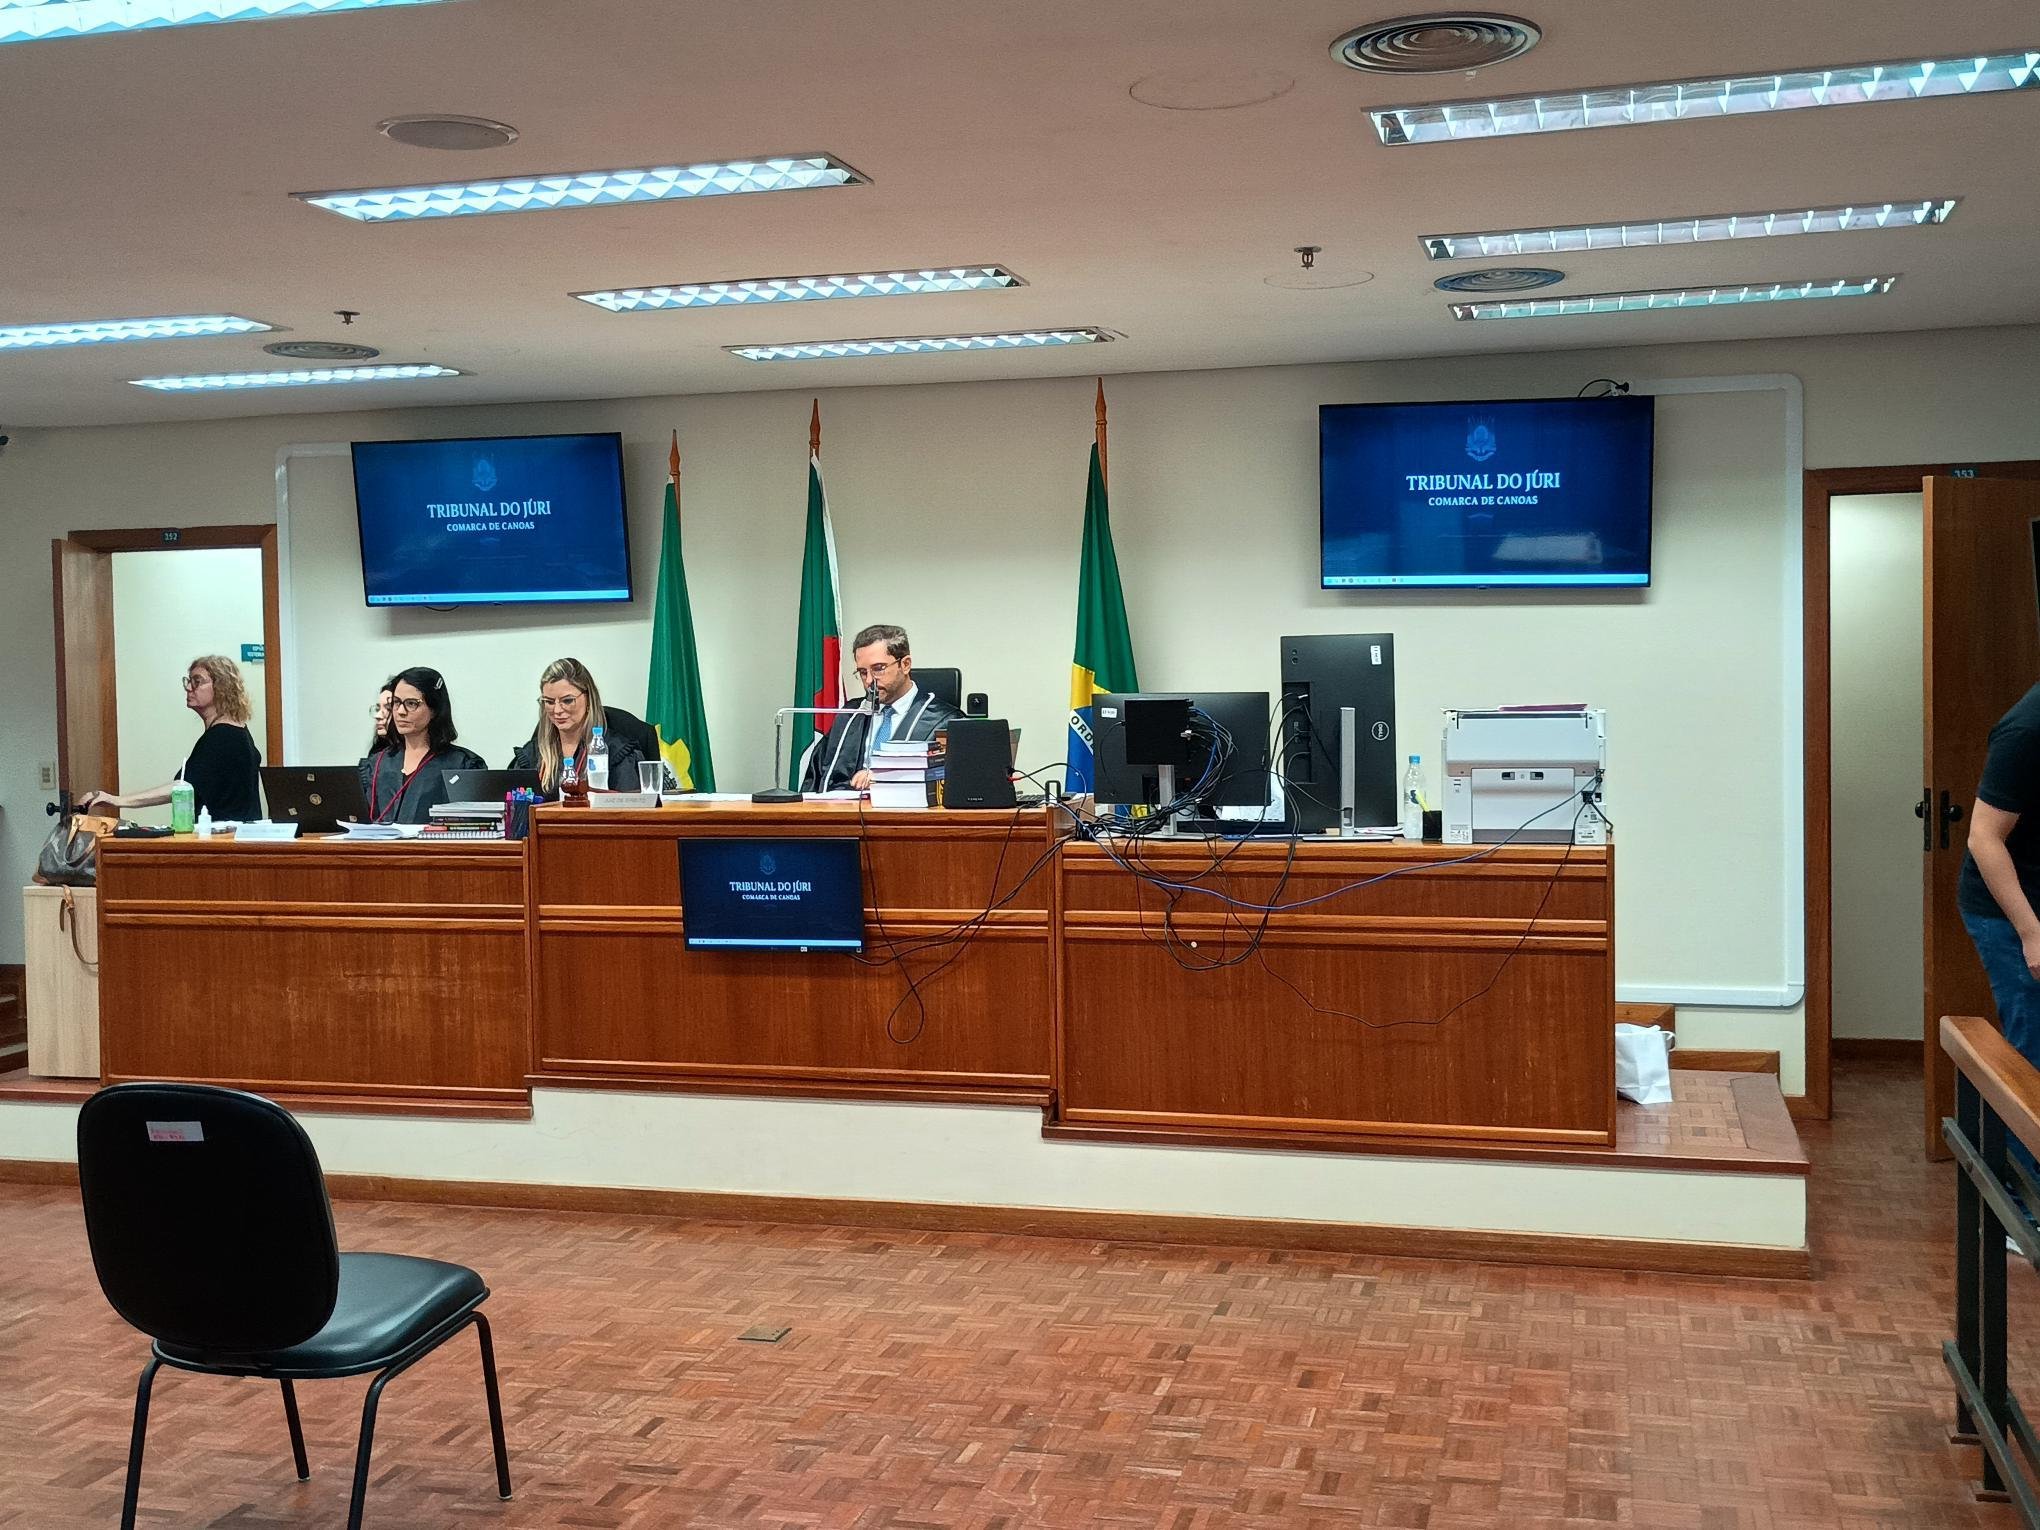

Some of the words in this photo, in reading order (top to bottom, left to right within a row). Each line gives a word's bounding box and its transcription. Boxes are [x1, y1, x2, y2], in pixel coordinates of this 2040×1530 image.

[1405, 473, 1493, 491] TRIBUNAL
[1497, 472, 1522, 489] DO
[1525, 469, 1560, 492] JÚRI
[1428, 496, 1478, 506] COMARCA
[1481, 496, 1494, 505] DE
[1497, 495, 1538, 505] CANOAS
[427, 503, 497, 518] TRIBUNAL
[500, 501, 520, 516] DO
[523, 498, 551, 519] JÚRI
[446, 523, 487, 532] COMARCA
[489, 523, 500, 531] DE
[502, 521, 535, 531] CANOAS
[729, 881, 776, 892] TRIBUNAL
[778, 882, 791, 892] DO
[793, 880, 812, 893] JÚRI
